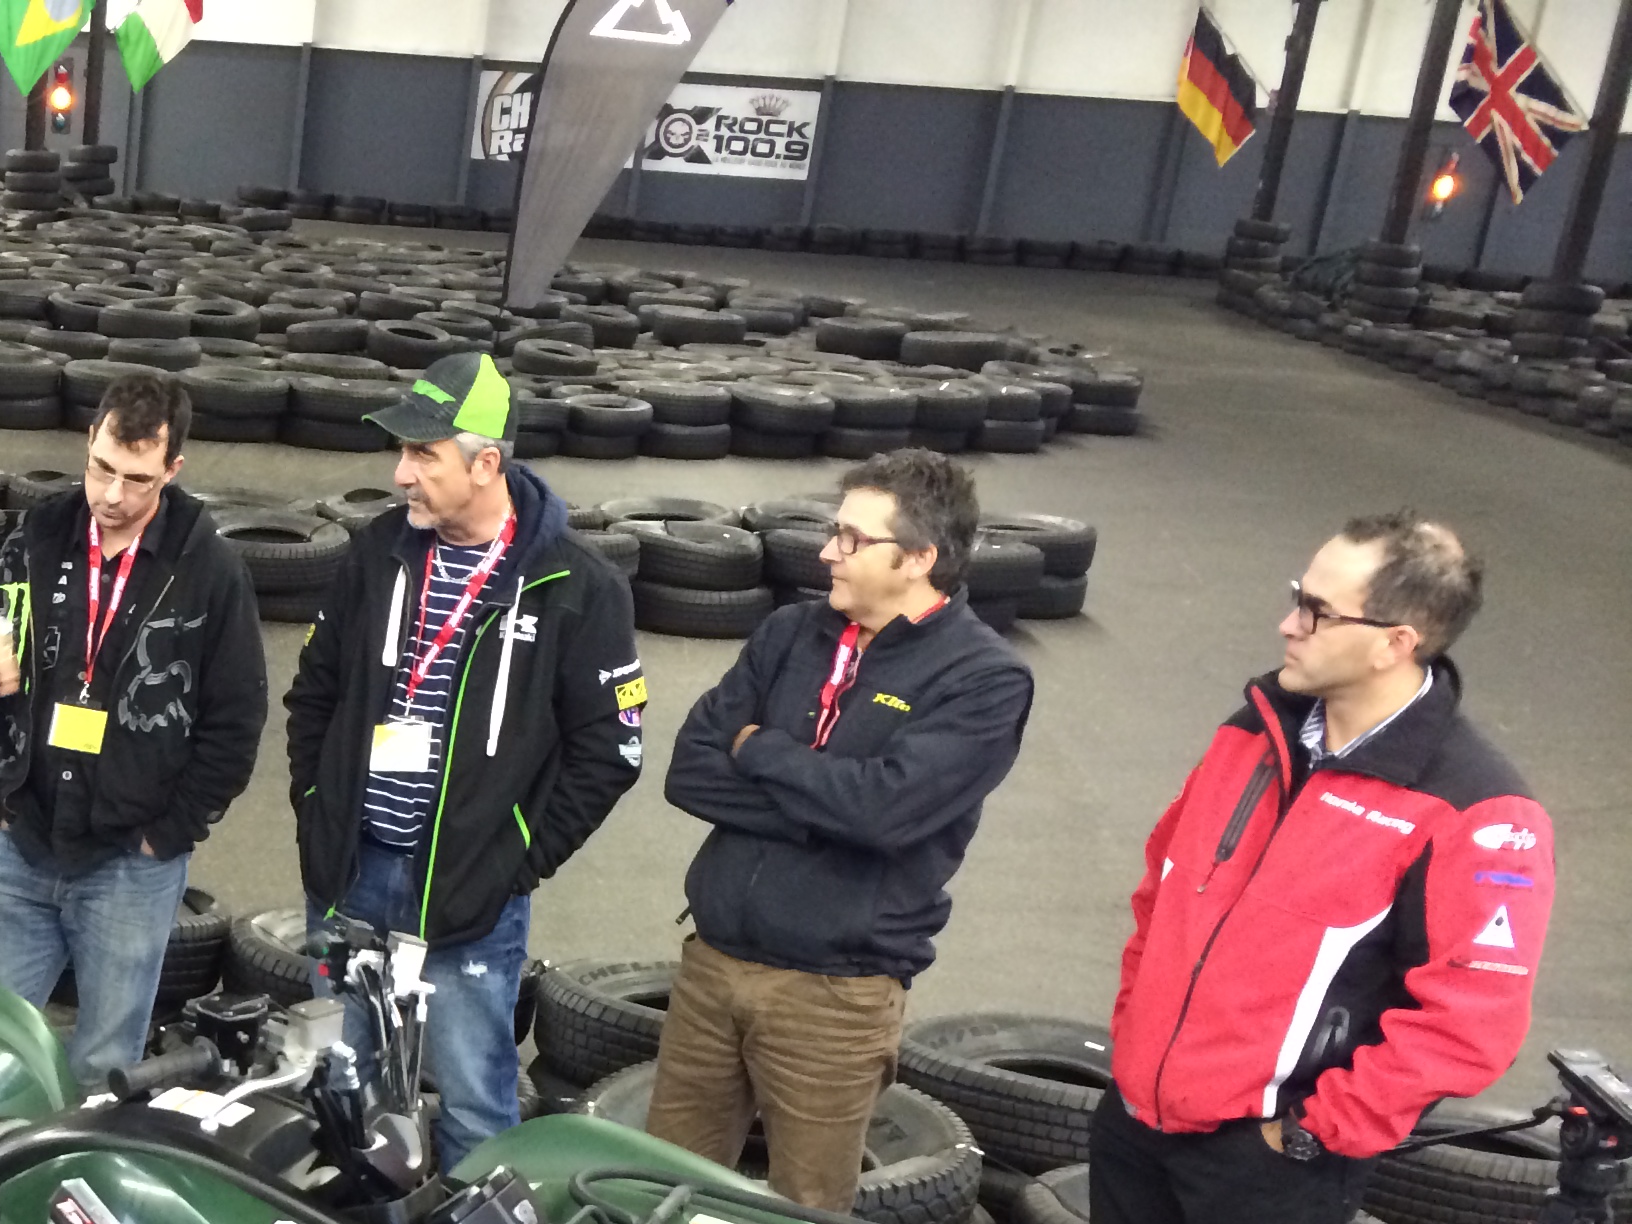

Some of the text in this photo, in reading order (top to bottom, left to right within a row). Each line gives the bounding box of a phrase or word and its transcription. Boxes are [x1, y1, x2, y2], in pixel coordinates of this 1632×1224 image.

[490, 91, 535, 131] CH
[714, 114, 813, 140] ROCK
[712, 133, 811, 162] 100.9
